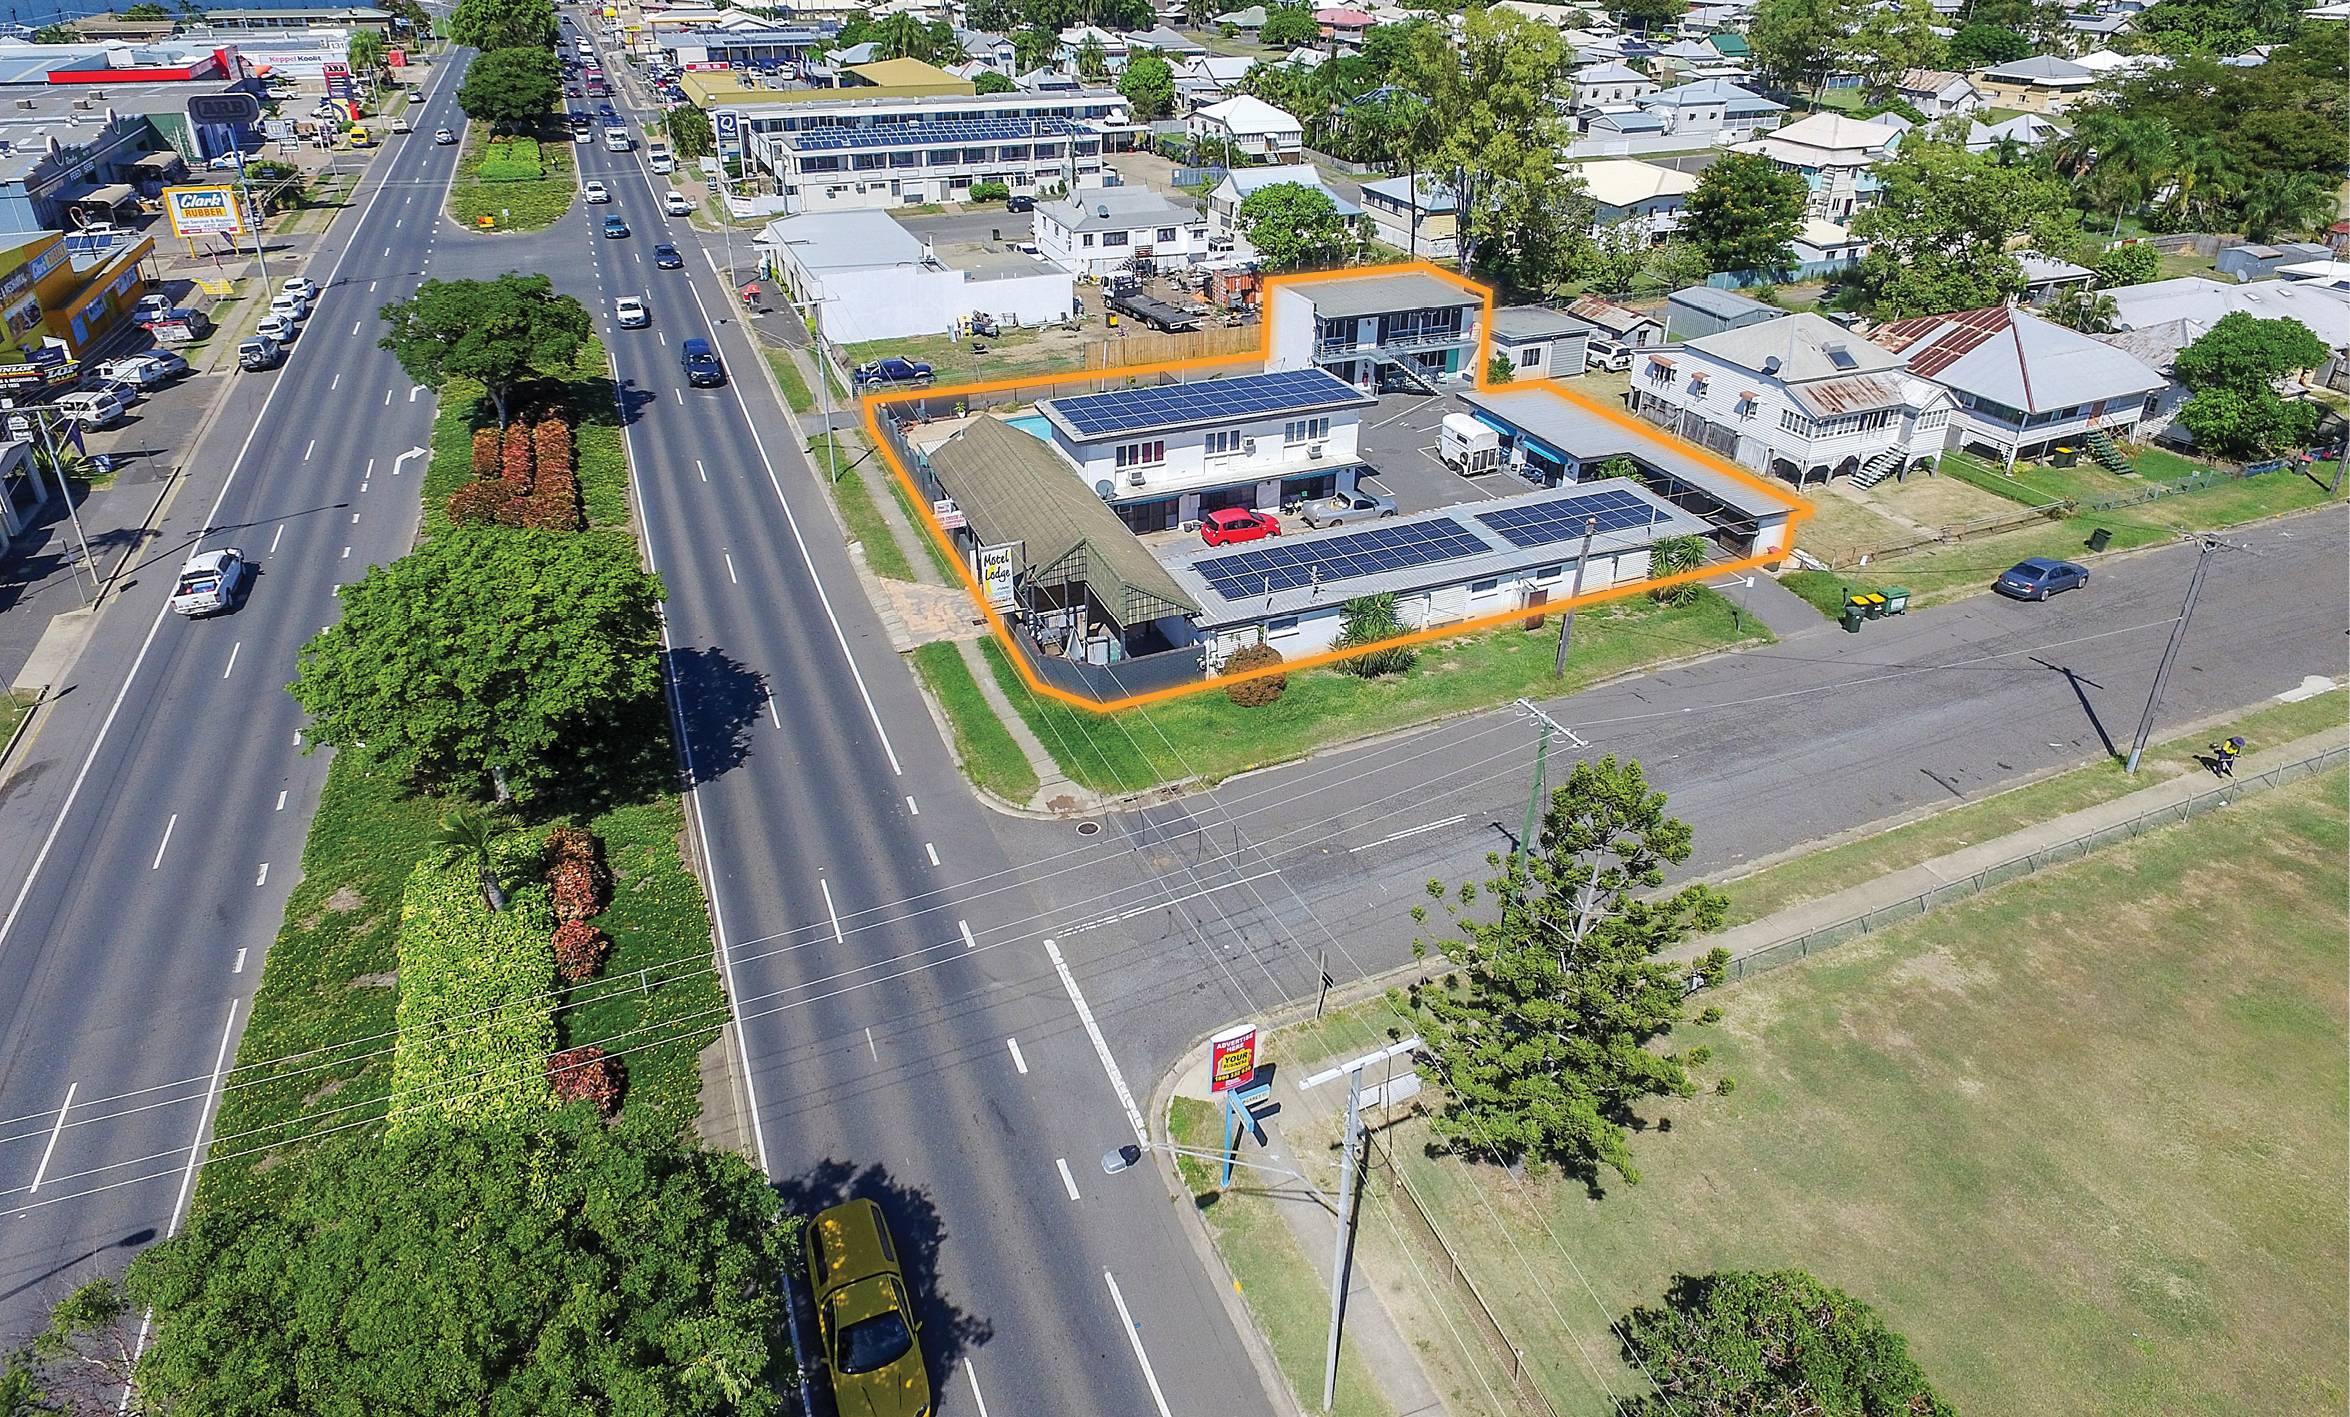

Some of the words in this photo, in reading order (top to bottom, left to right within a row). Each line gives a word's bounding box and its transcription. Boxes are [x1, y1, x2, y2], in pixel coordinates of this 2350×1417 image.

[201, 101, 246, 114] ARB
[180, 193, 222, 208] Clark
[184, 207, 223, 218] RUBBER
[984, 549, 1010, 567] Motel
[985, 566, 1011, 583] Lodge
[1216, 1033, 1254, 1049] ADVERTISE
[1226, 1042, 1245, 1052] HERE
[1224, 1051, 1248, 1063] YOUR
[1223, 1059, 1247, 1069] BUSINESS
